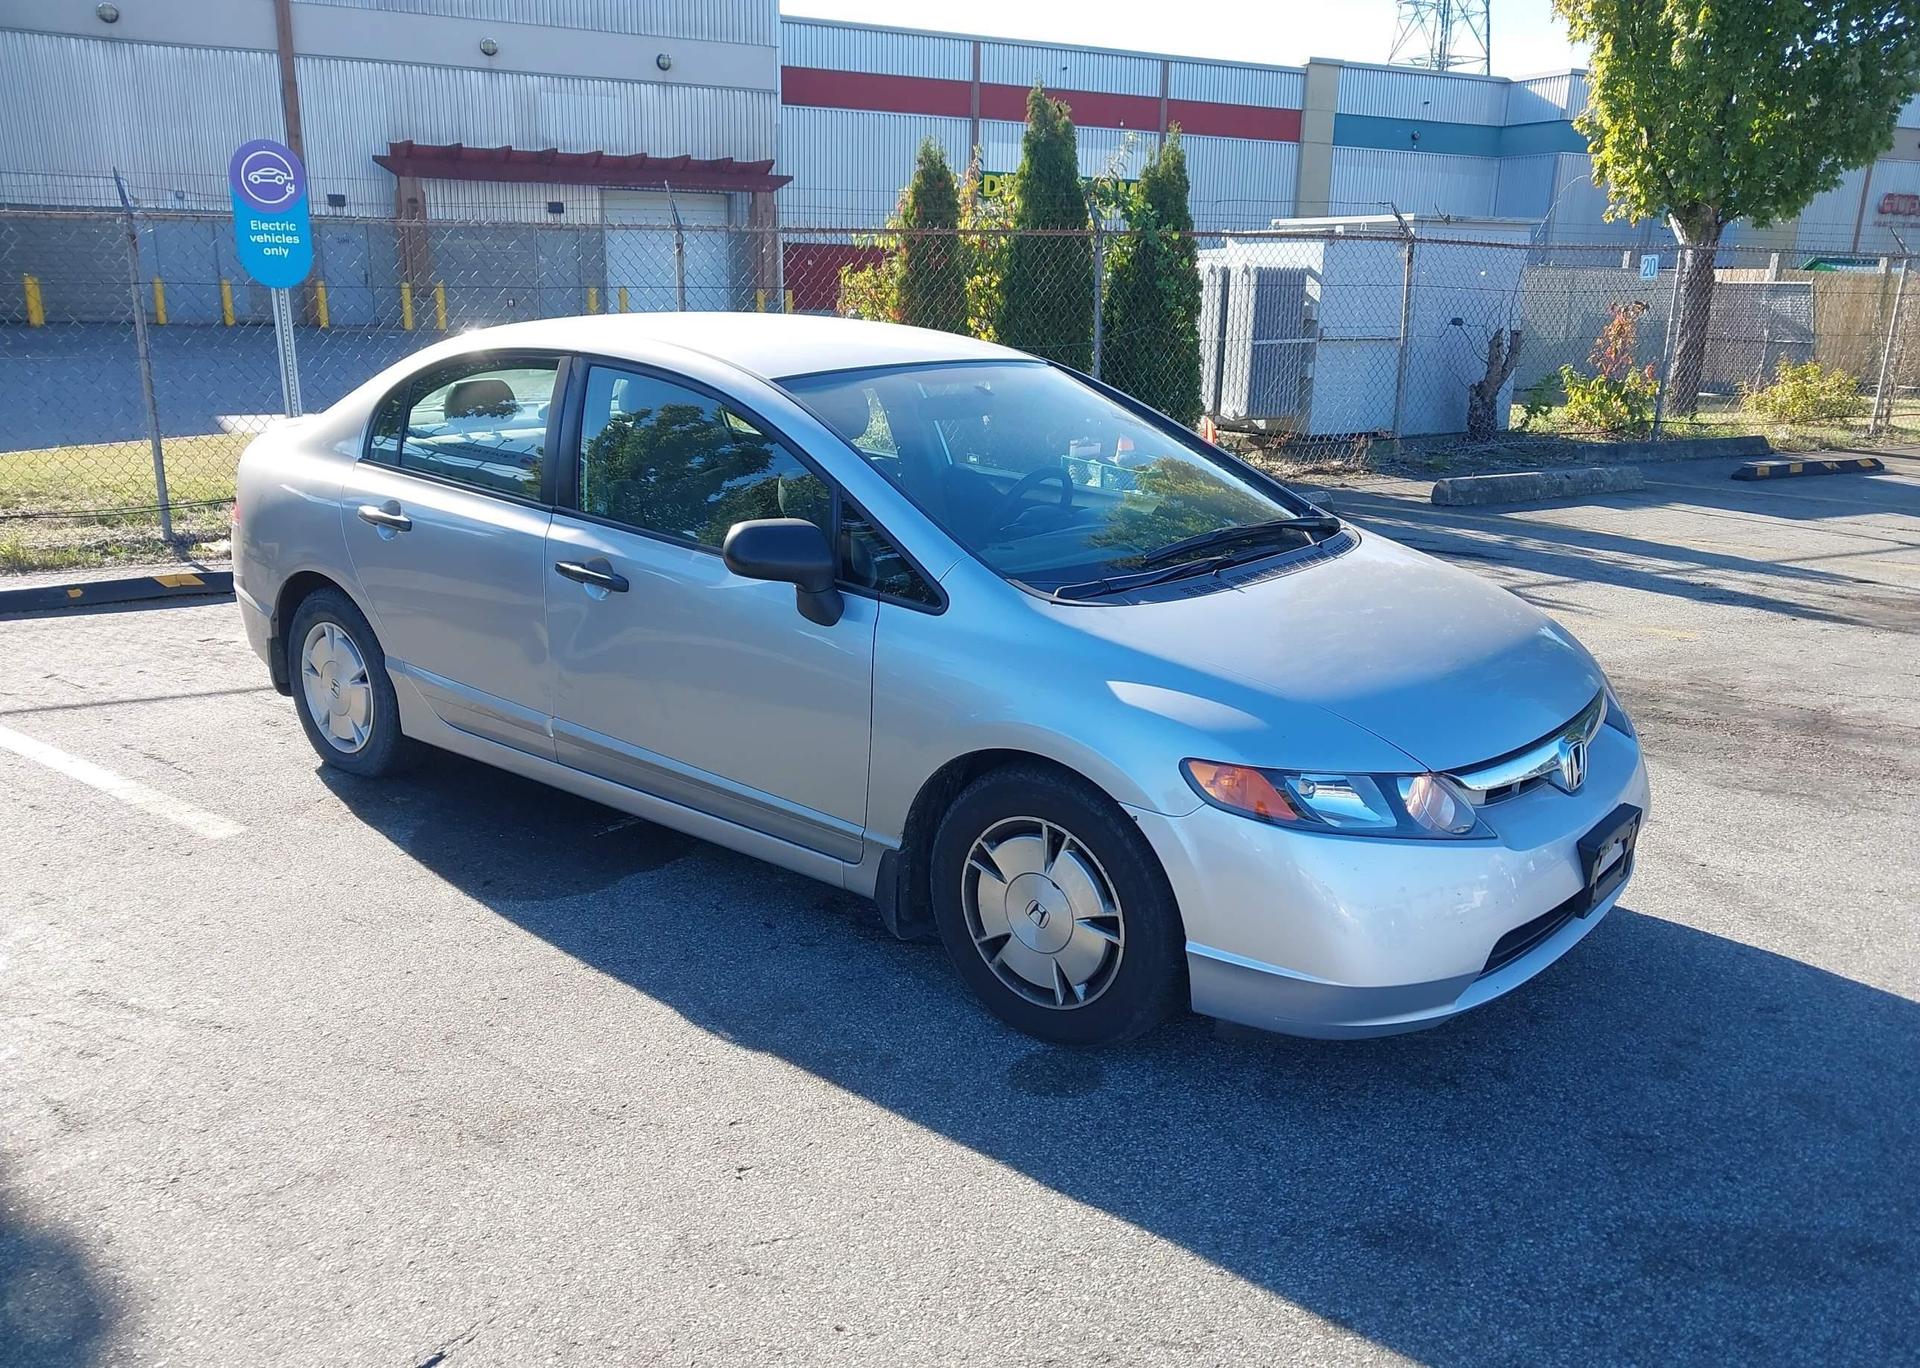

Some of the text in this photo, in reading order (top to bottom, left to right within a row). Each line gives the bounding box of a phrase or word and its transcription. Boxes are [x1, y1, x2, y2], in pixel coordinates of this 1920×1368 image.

[250, 220, 297, 231] Electric
[249, 233, 300, 244] vehicles
[263, 246, 289, 258] only
[1642, 257, 1656, 277] 20
